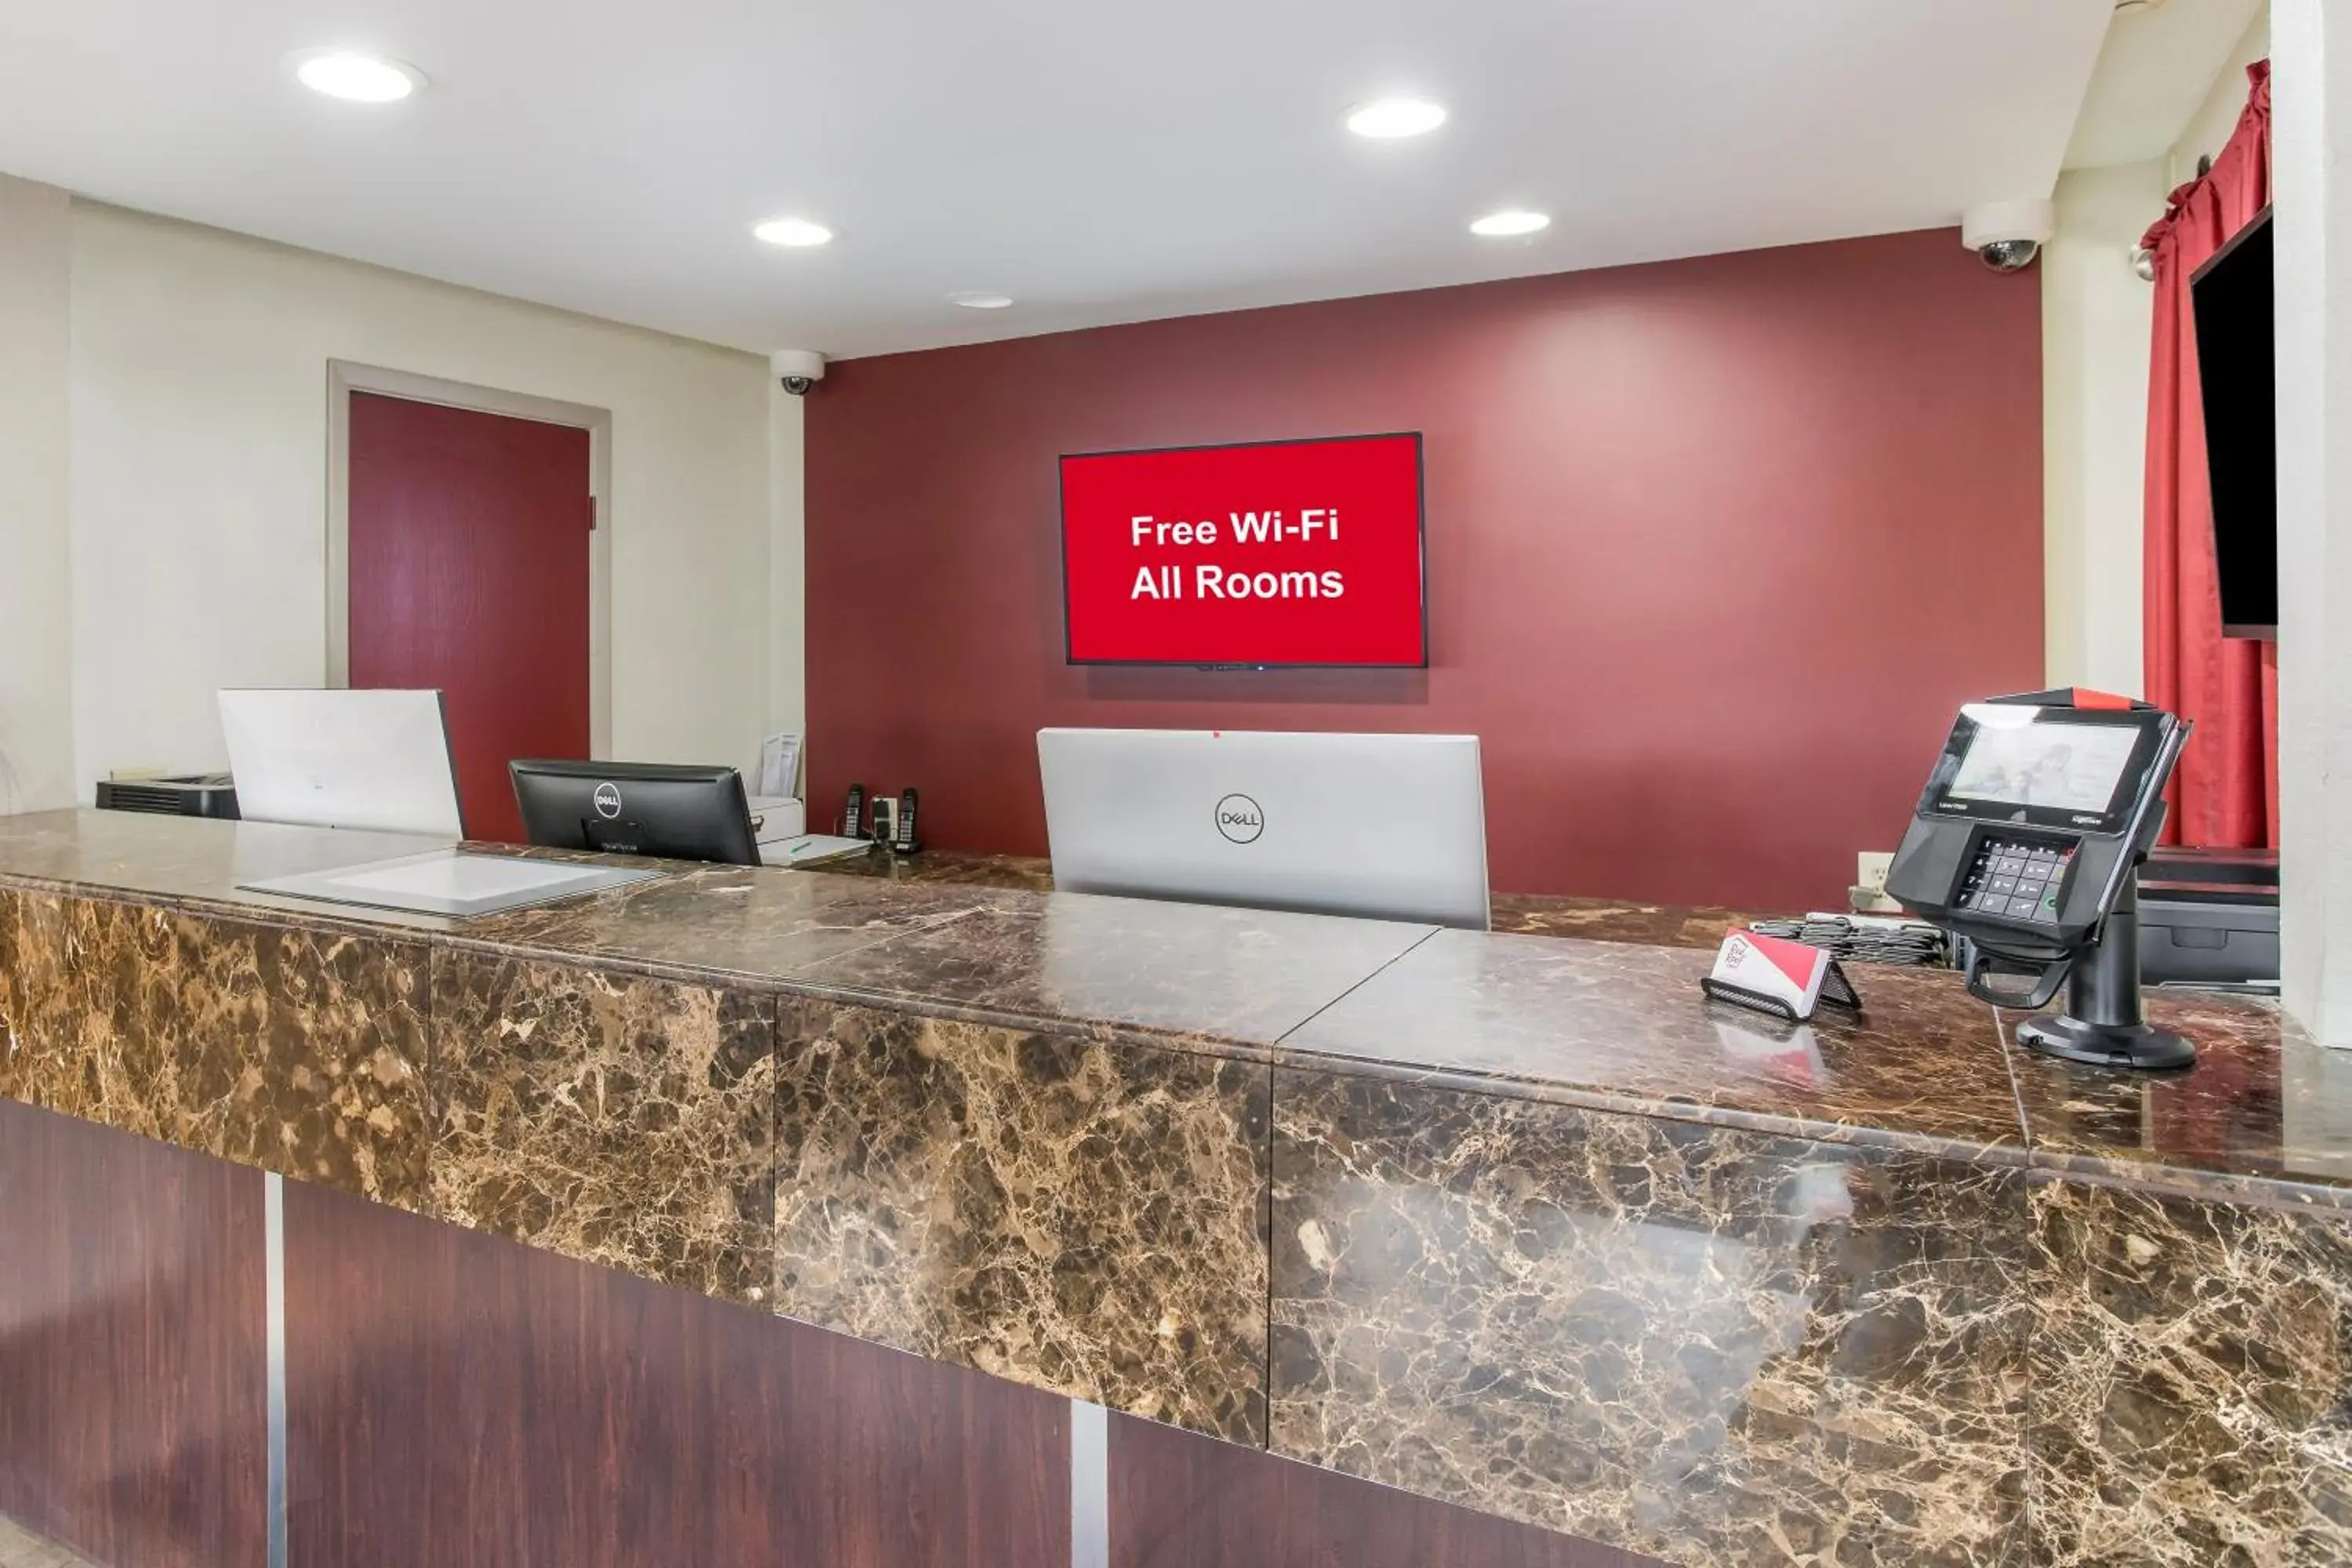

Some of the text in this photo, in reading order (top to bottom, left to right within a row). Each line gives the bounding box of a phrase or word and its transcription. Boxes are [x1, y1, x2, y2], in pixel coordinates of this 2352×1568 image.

[1131, 509, 1338, 546] Free Wi-Fi
[1131, 564, 1345, 599] All Rooms
[597, 796, 618, 806] DELL
[1221, 812, 1259, 826] DELL
